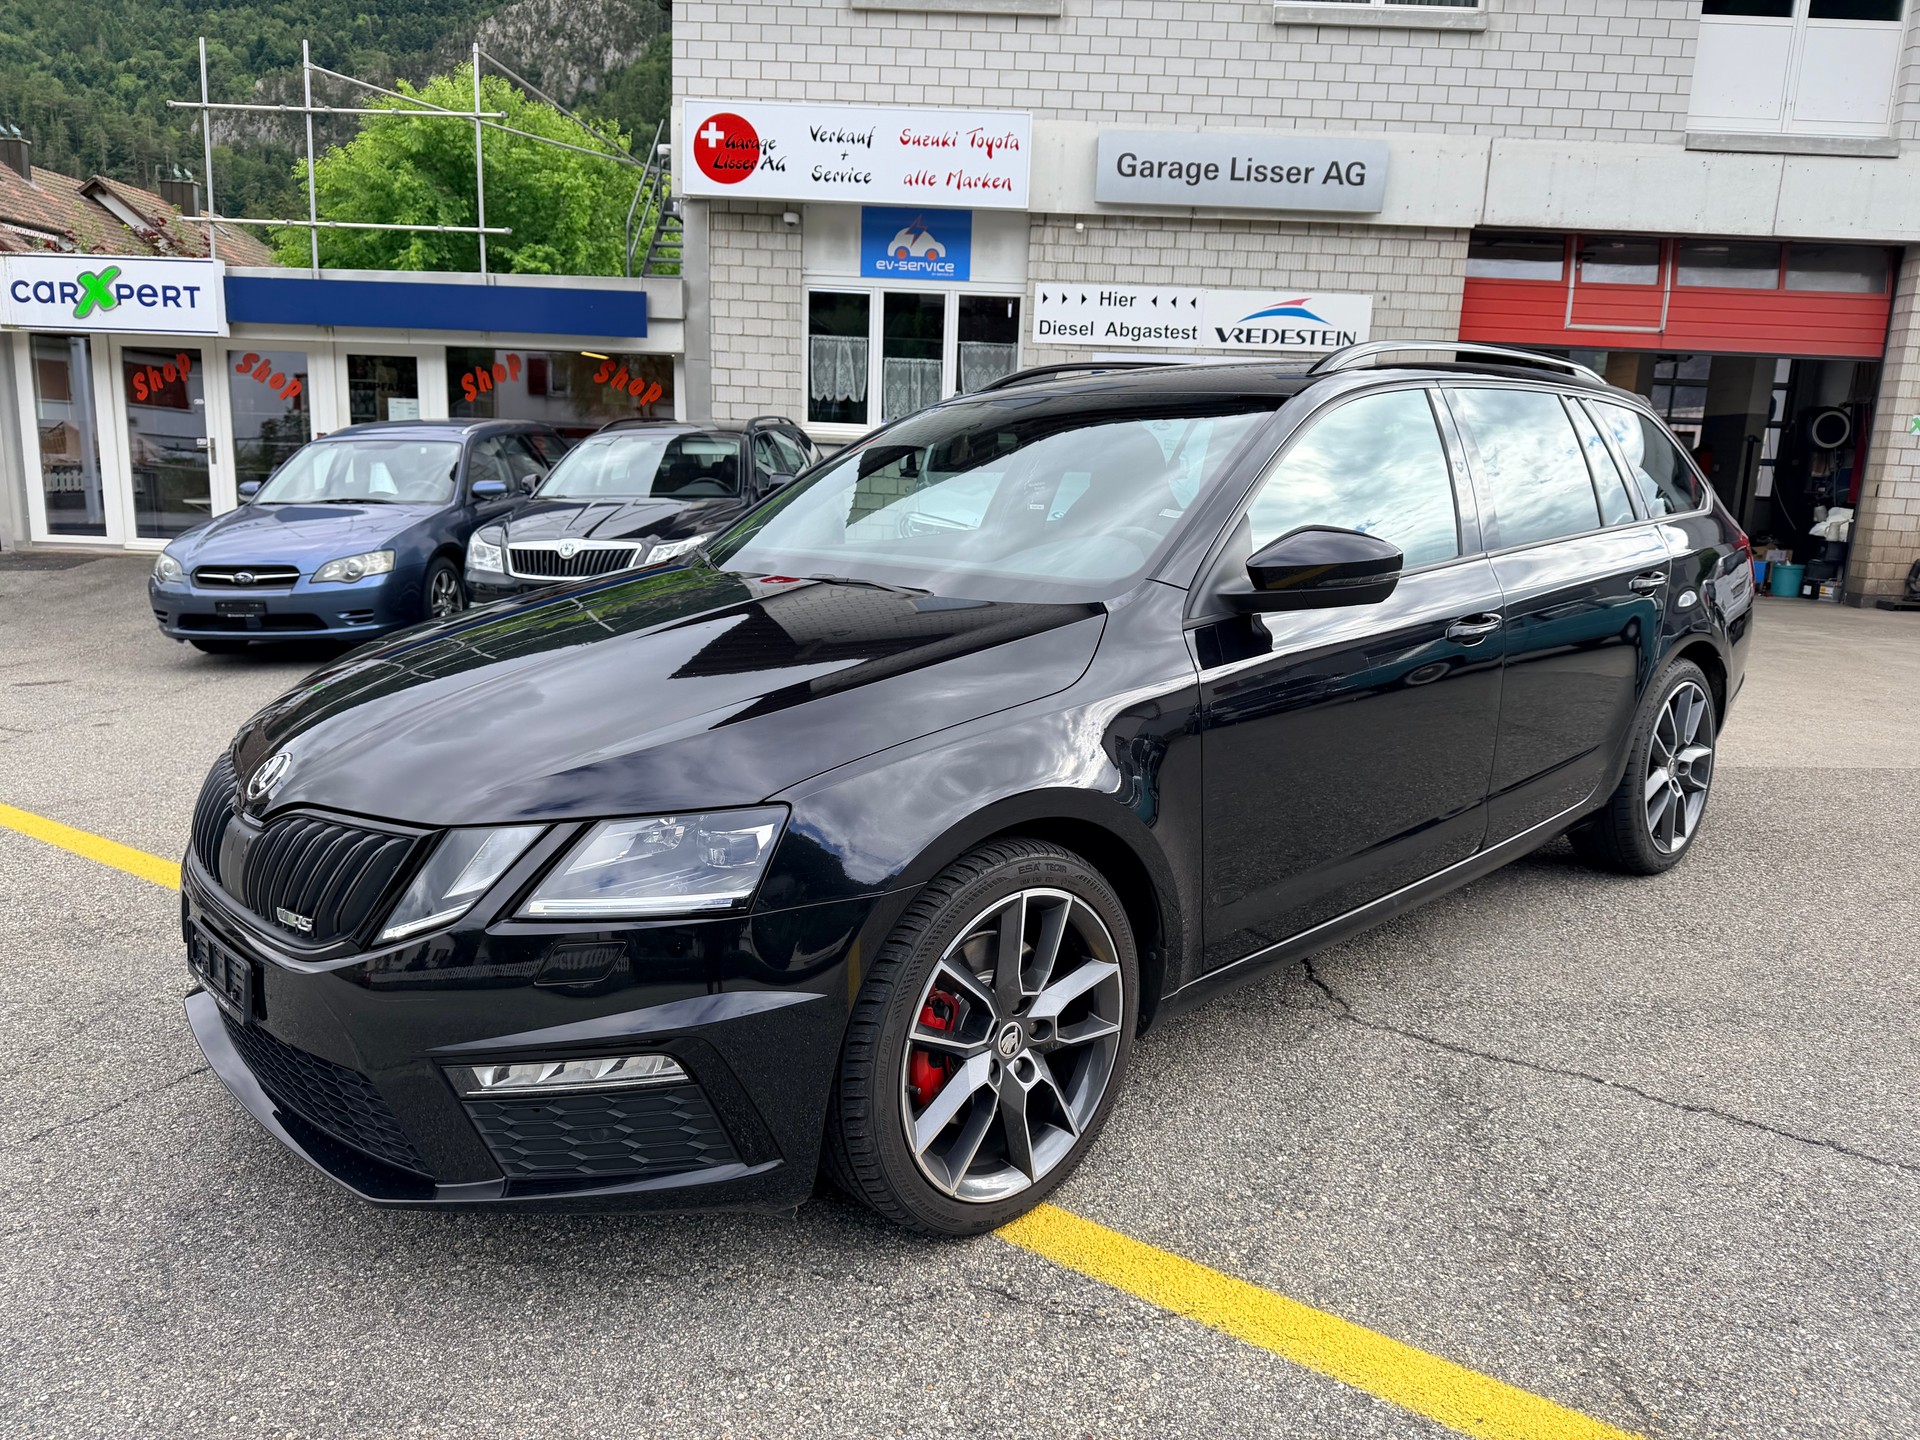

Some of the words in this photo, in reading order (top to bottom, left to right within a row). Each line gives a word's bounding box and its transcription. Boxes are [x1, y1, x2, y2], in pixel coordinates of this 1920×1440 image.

[725, 133, 777, 155] Garage
[809, 125, 876, 149] Verkauf
[899, 128, 959, 148] Suzuki
[965, 126, 1020, 160] Toyota
[713, 152, 757, 171] Lisser
[1116, 152, 1220, 186] Garage
[1229, 156, 1315, 184] Lisser
[1321, 160, 1367, 186] AG
[811, 164, 873, 185] Service
[903, 169, 937, 187] alle
[945, 169, 1012, 192] Marken
[875, 260, 955, 273] ev-service
[1099, 290, 1137, 308] Hier
[1038, 319, 1095, 336] Diesel
[1104, 321, 1198, 342] Abgastest
[1214, 326, 1357, 347] VREDESTEIN
[132, 352, 192, 401] Shop
[235, 352, 303, 401] Shop
[461, 353, 522, 402] Shop
[593, 360, 663, 406] Shop
